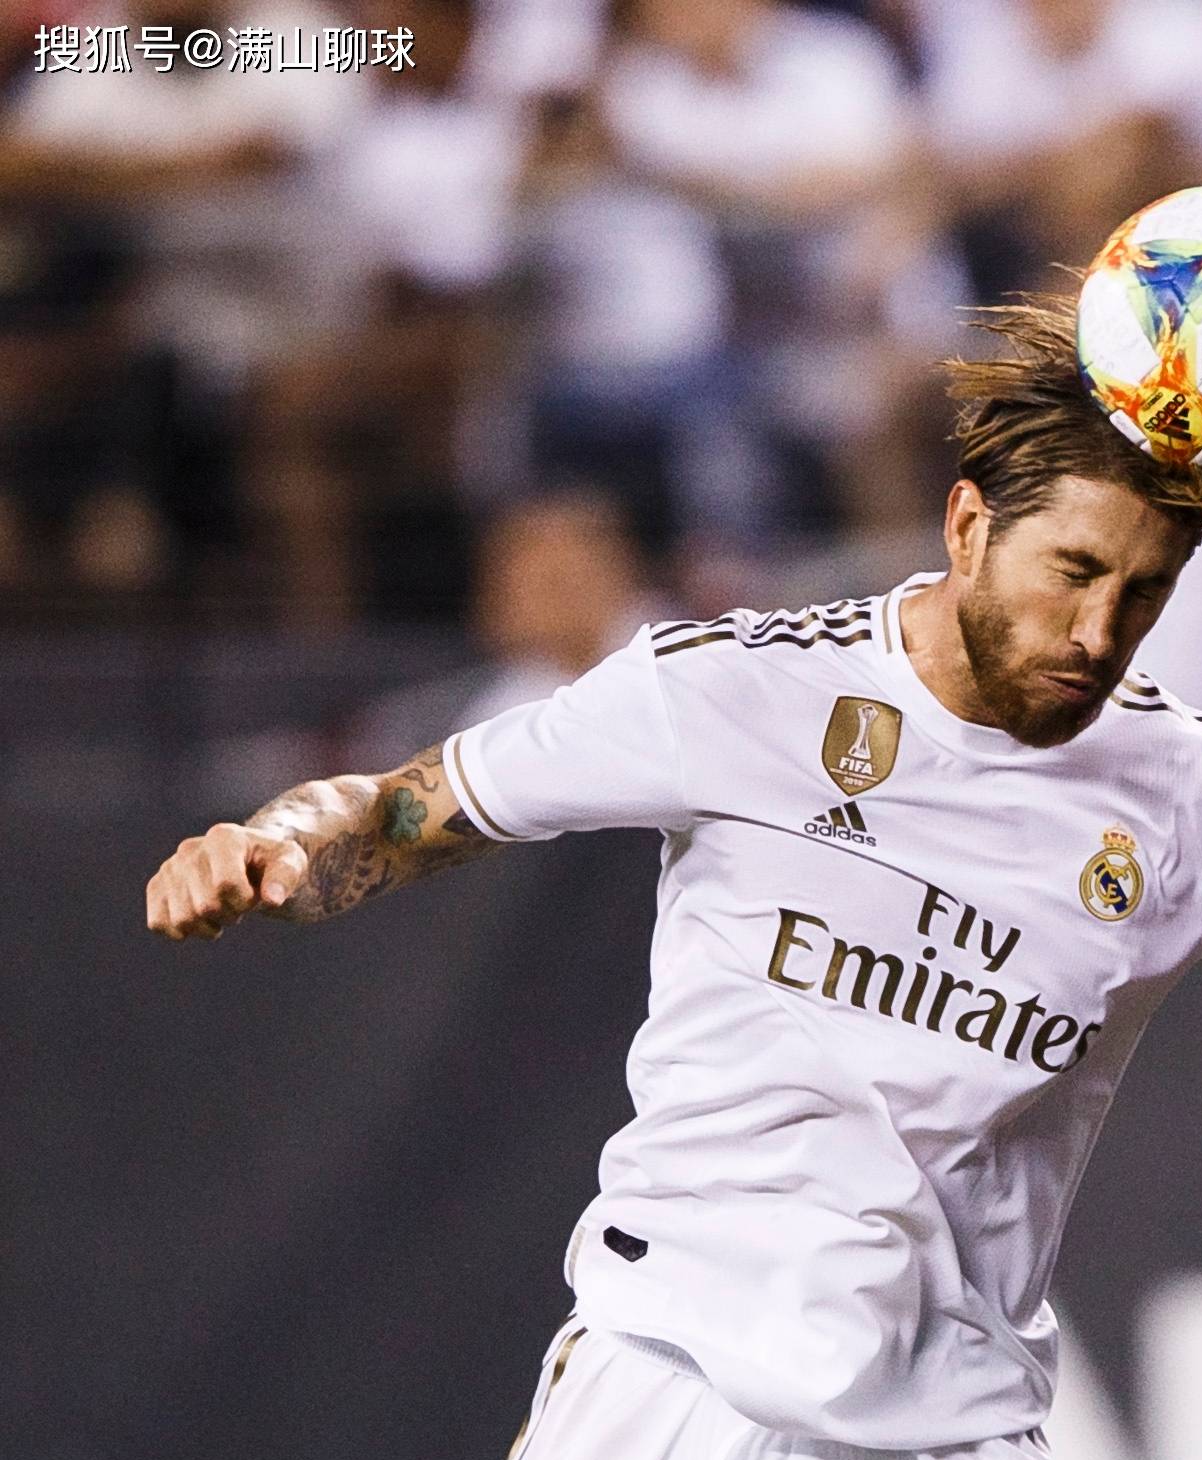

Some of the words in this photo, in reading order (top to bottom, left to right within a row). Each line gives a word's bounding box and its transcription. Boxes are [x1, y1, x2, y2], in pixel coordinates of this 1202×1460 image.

[1144, 393, 1186, 432] adidas
[838, 756, 873, 775] FIFA
[804, 822, 877, 847] adidas
[917, 882, 1021, 972] Fly
[768, 907, 1102, 1074] Emirates
